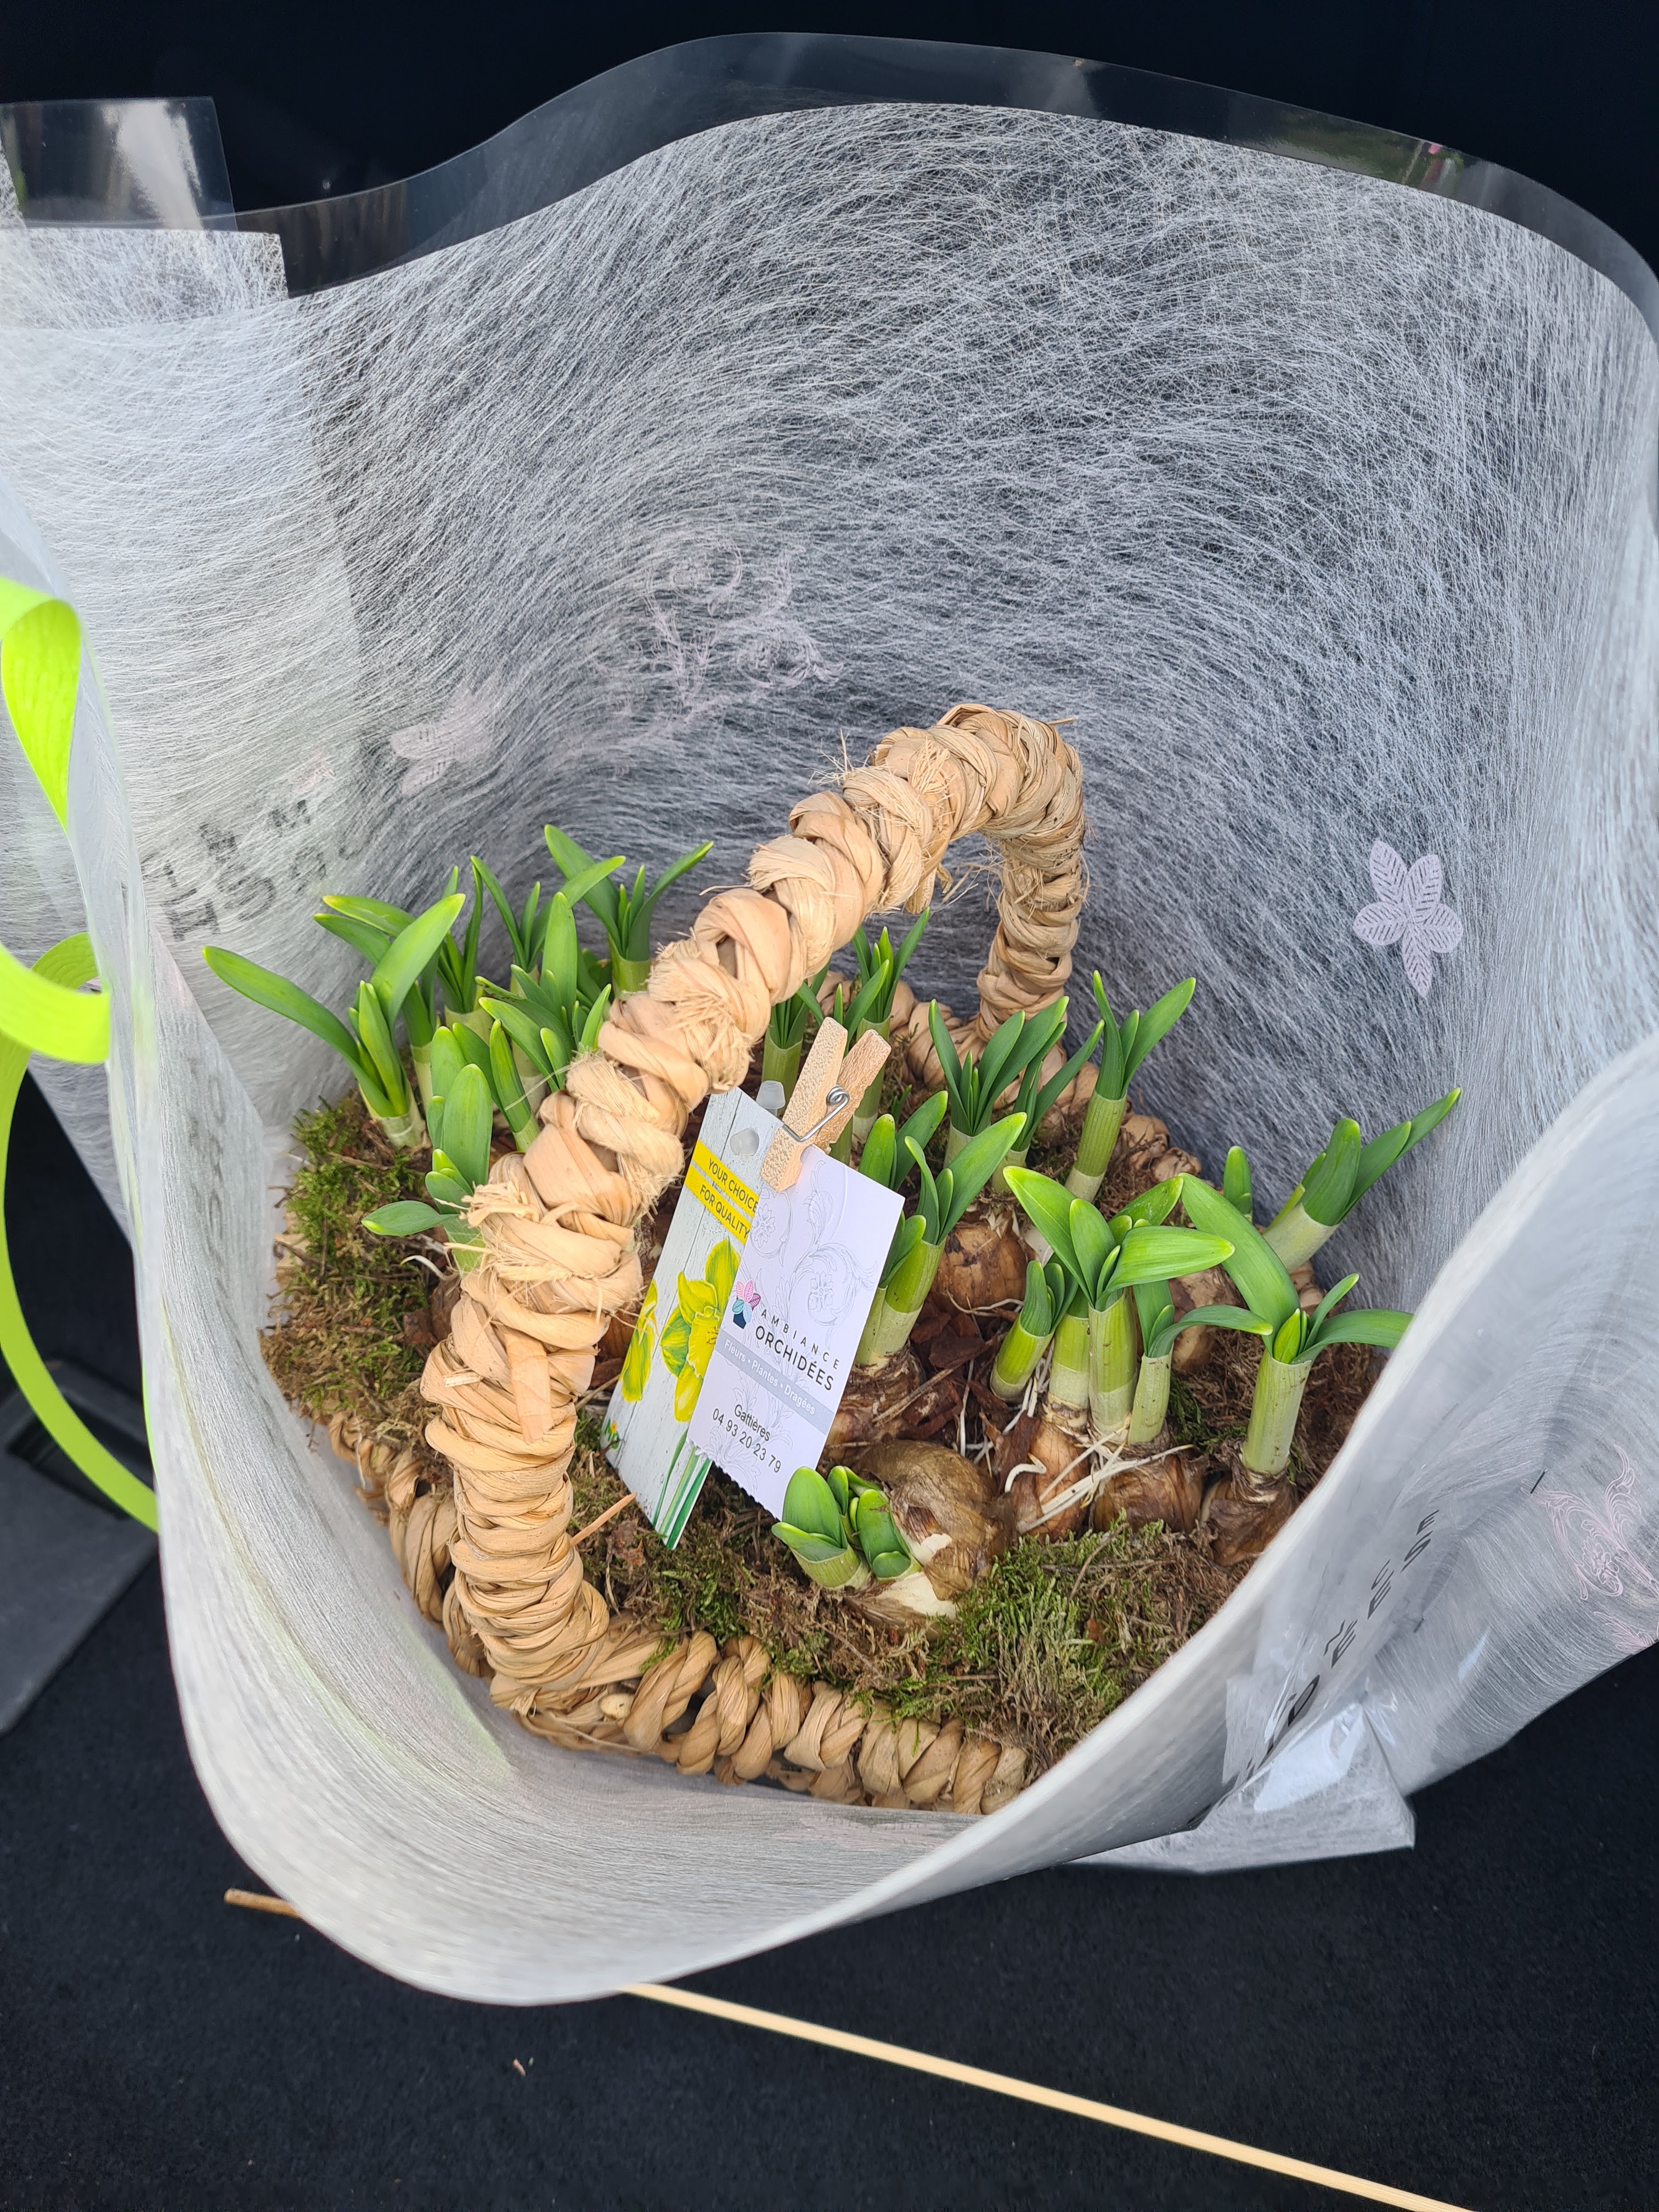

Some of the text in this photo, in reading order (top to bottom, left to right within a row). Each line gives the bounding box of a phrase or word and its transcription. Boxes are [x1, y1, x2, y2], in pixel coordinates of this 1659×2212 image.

[699, 1184, 750, 1239] FOR QUALITY
[708, 1158, 759, 1213] YOUR CHOICE
[755, 1326, 834, 1391] ORCHIDÉES
[761, 1309, 839, 1369] AMBIANCE
[724, 1339, 816, 1415] Fleurs Plantes Dragées
[713, 1408, 781, 1473] 04 93 20 23 79
[734, 1404, 770, 1441] Gattières
